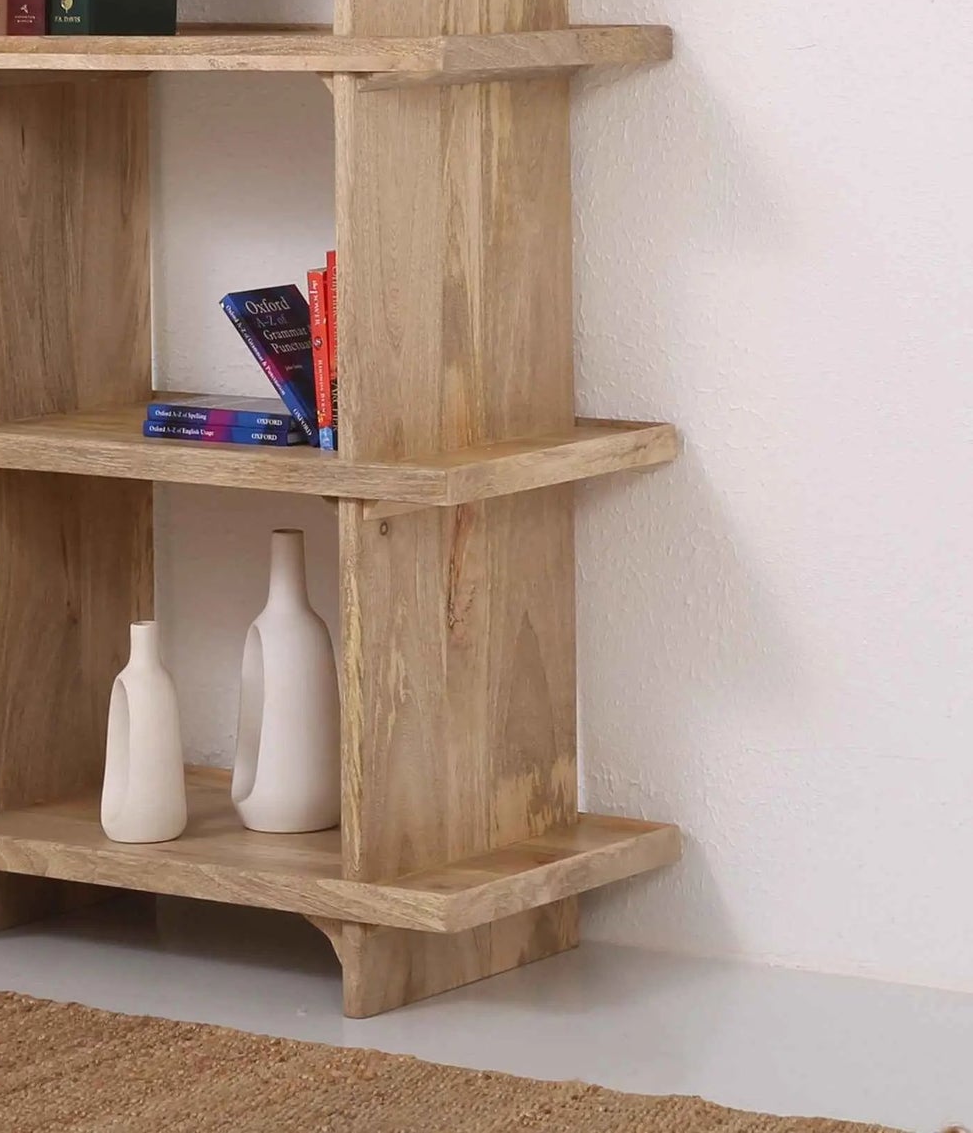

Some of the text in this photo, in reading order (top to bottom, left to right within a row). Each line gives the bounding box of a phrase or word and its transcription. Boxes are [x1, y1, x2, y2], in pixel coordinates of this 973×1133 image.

[245, 296, 291, 315] Oxford
[263, 327, 308, 340] Grammar
[271, 340, 312, 355] Punctua
[155, 409, 172, 417] Oxford
[188, 412, 207, 421] Spelling
[256, 417, 283, 426] OXFORD
[293, 408, 312, 436] OXFORD
[149, 425, 166, 433] Oxford
[182, 427, 200, 435] English
[251, 432, 278, 441] OXFORD
